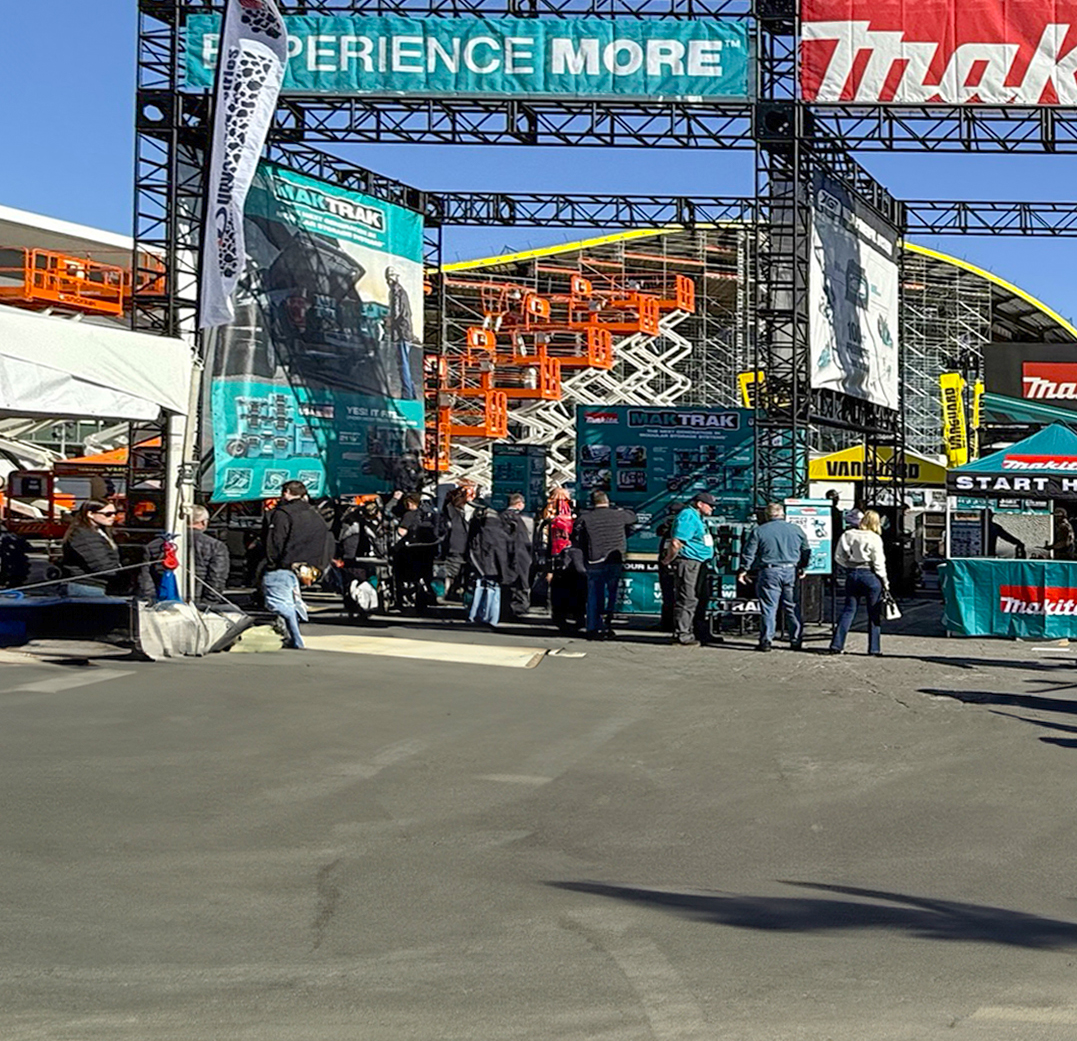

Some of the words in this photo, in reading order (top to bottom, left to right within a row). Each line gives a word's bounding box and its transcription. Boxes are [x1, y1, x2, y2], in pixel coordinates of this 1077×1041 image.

[202, 33, 534, 75] EPERIENCE
[631, 412, 735, 428] MAKTRAK
[945, 387, 962, 450] VANGUARD
[955, 476, 1050, 492] START
